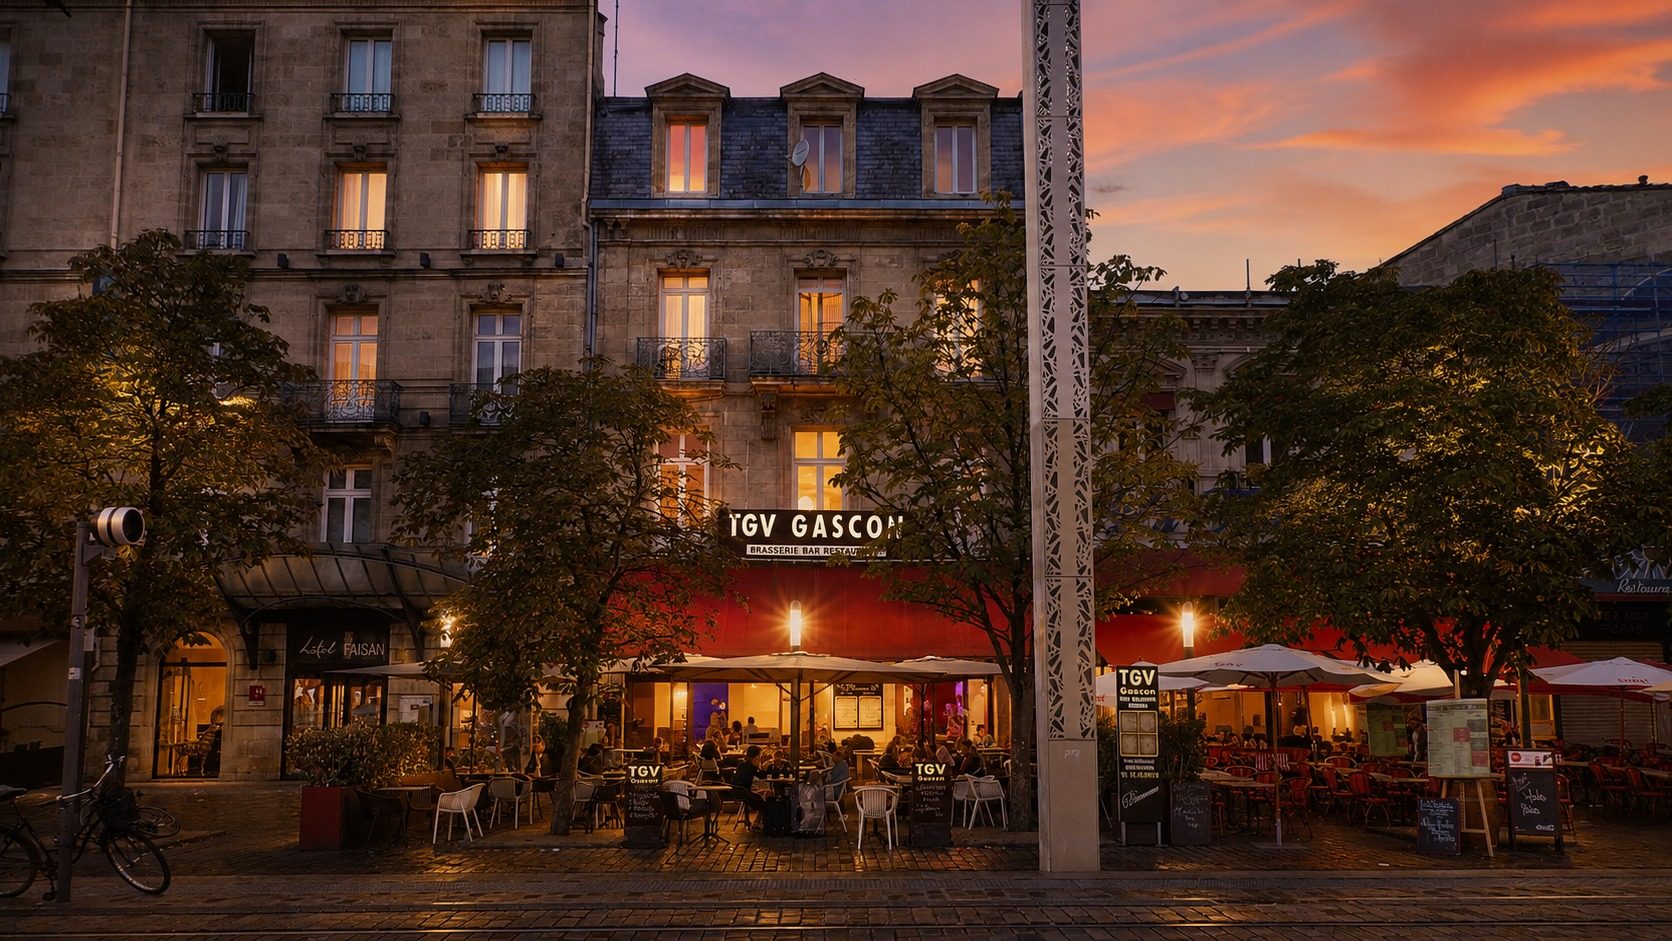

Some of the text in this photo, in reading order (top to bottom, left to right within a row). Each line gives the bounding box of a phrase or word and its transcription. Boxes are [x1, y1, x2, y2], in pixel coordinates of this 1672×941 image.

[729, 513, 776, 538] TGV
[750, 546, 799, 555] BRASSERIE
[802, 547, 820, 556] BAR
[343, 643, 385, 656] FAISAN
[1119, 669, 1155, 686] TGV
[1120, 686, 1156, 695] Gascon
[628, 765, 660, 777] TGV
[915, 763, 946, 775] TGV
